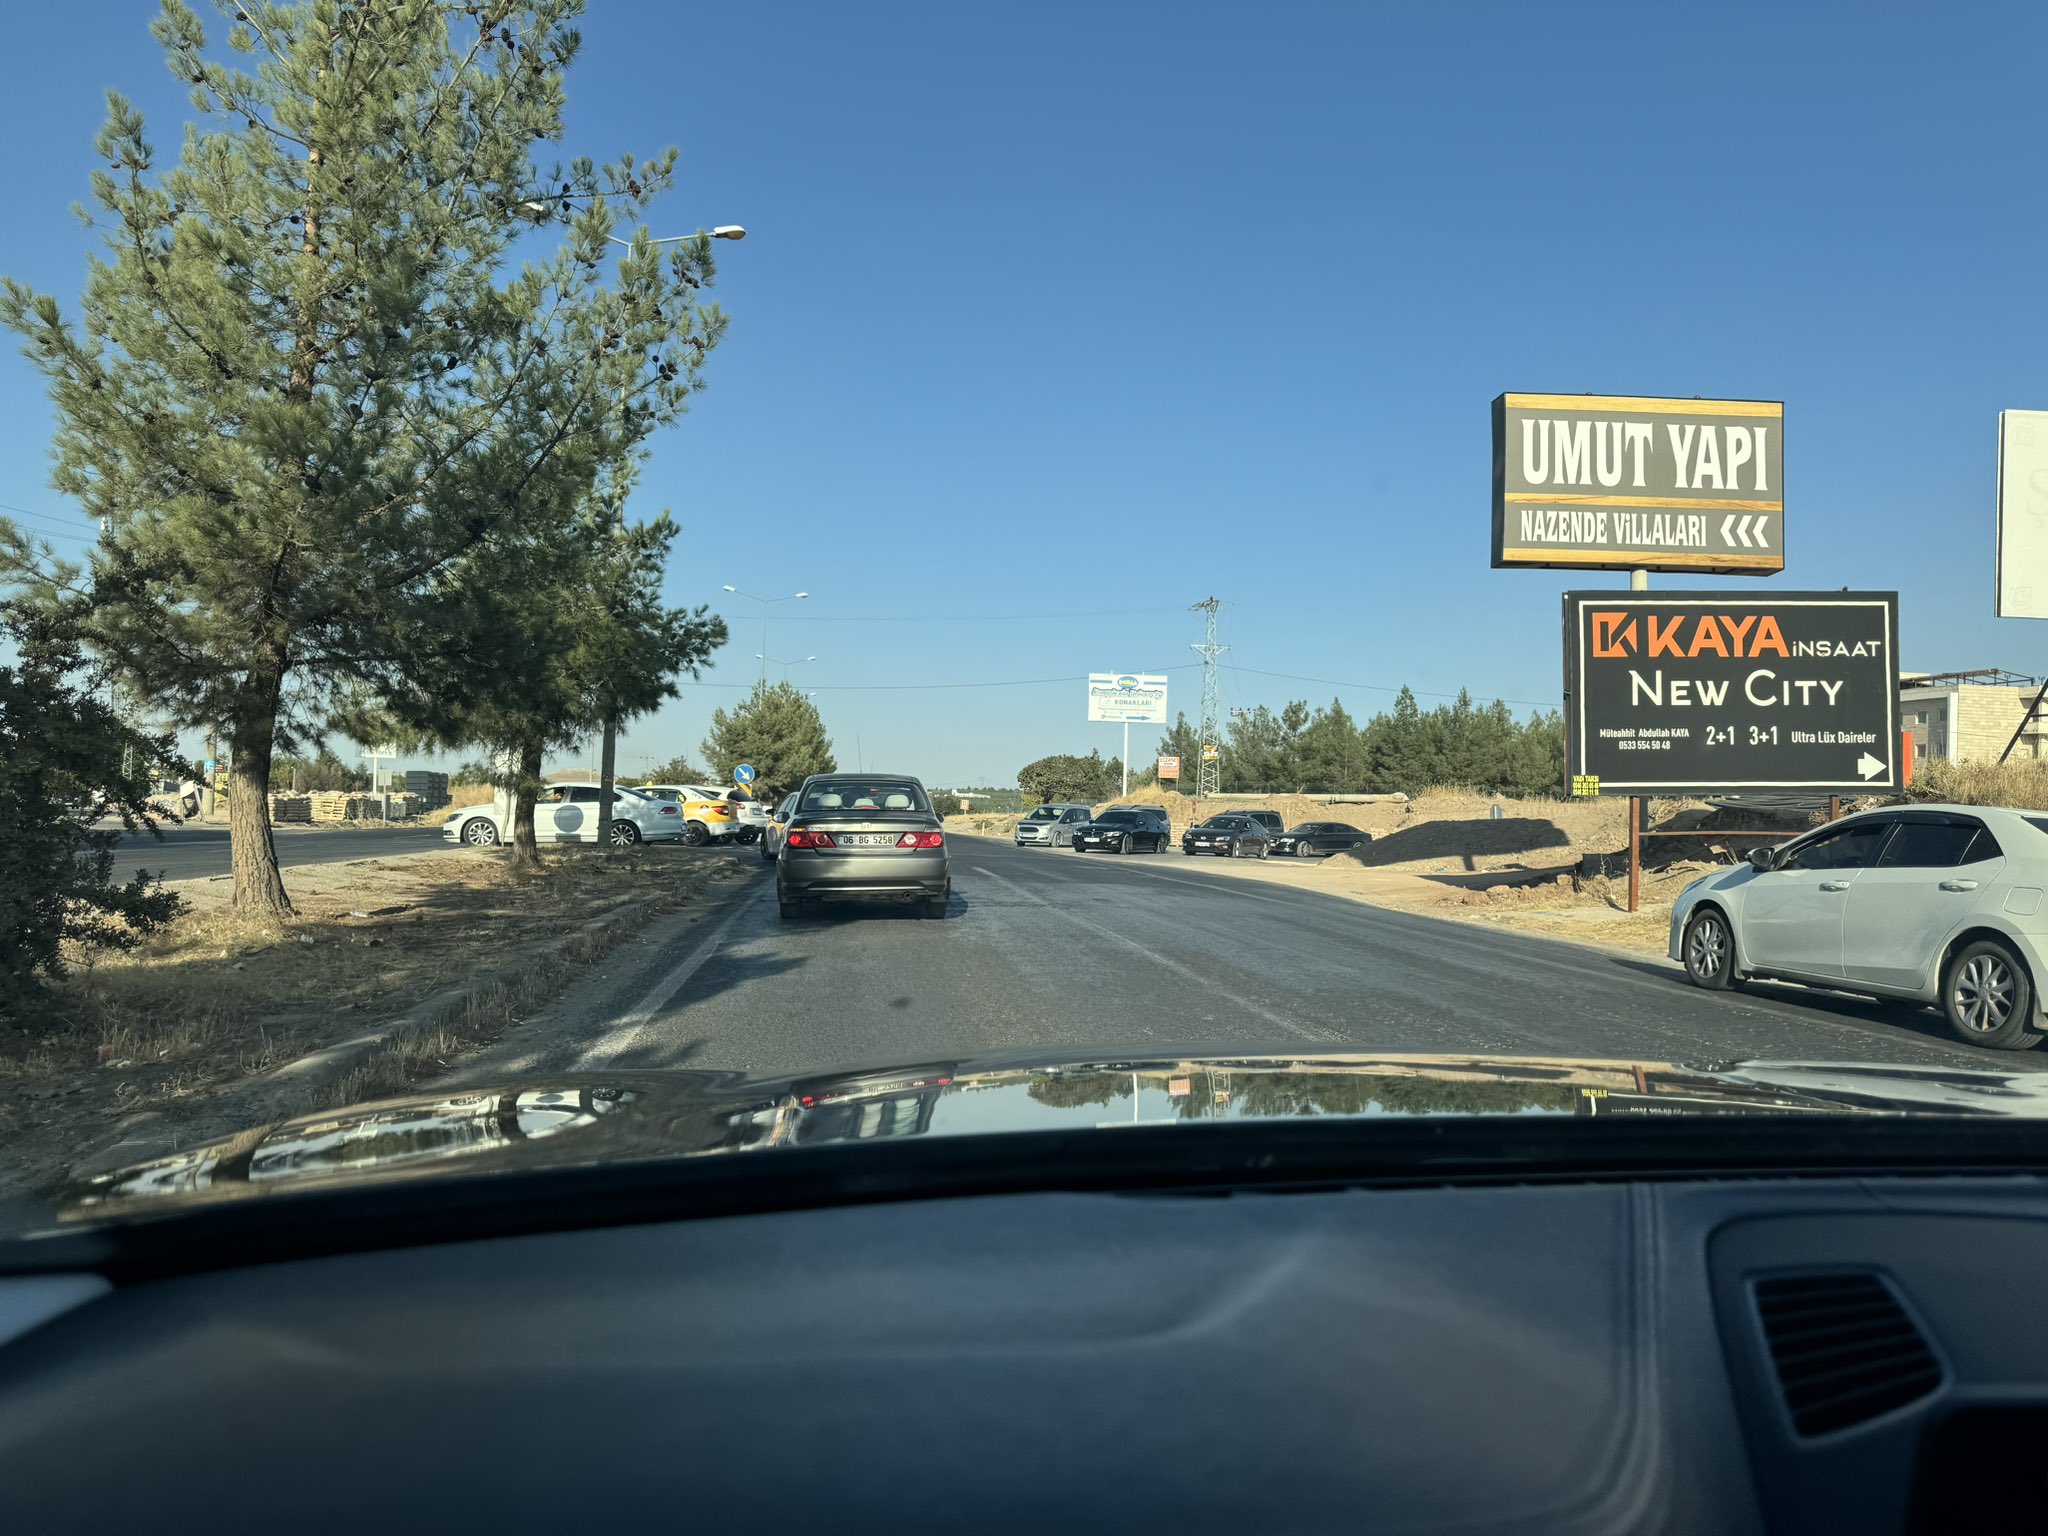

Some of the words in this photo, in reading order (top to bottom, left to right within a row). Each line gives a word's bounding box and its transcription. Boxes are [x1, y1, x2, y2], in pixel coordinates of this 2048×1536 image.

[1521, 419, 1653, 487] UMUT
[1666, 424, 1768, 491] YAPI
[1520, 510, 1608, 544] NAZENDE
[1647, 615, 1790, 658] KAYA
[1638, 728, 1670, 738] Abdullah
[1671, 728, 1690, 738] KAYA
[1706, 726, 1735, 746] 2+1
[1749, 726, 1778, 746] 3+1
[1791, 731, 1816, 743] Ultra
[1818, 731, 1836, 744] Lüx
[1838, 731, 1876, 744] Daireler
[1618, 740, 1636, 750] 0533
[1637, 740, 1650, 750] 554
[1651, 740, 1661, 750] 50
[1661, 740, 1671, 750] 48
[843, 835, 854, 844] 06
[873, 835, 893, 844] 5258
